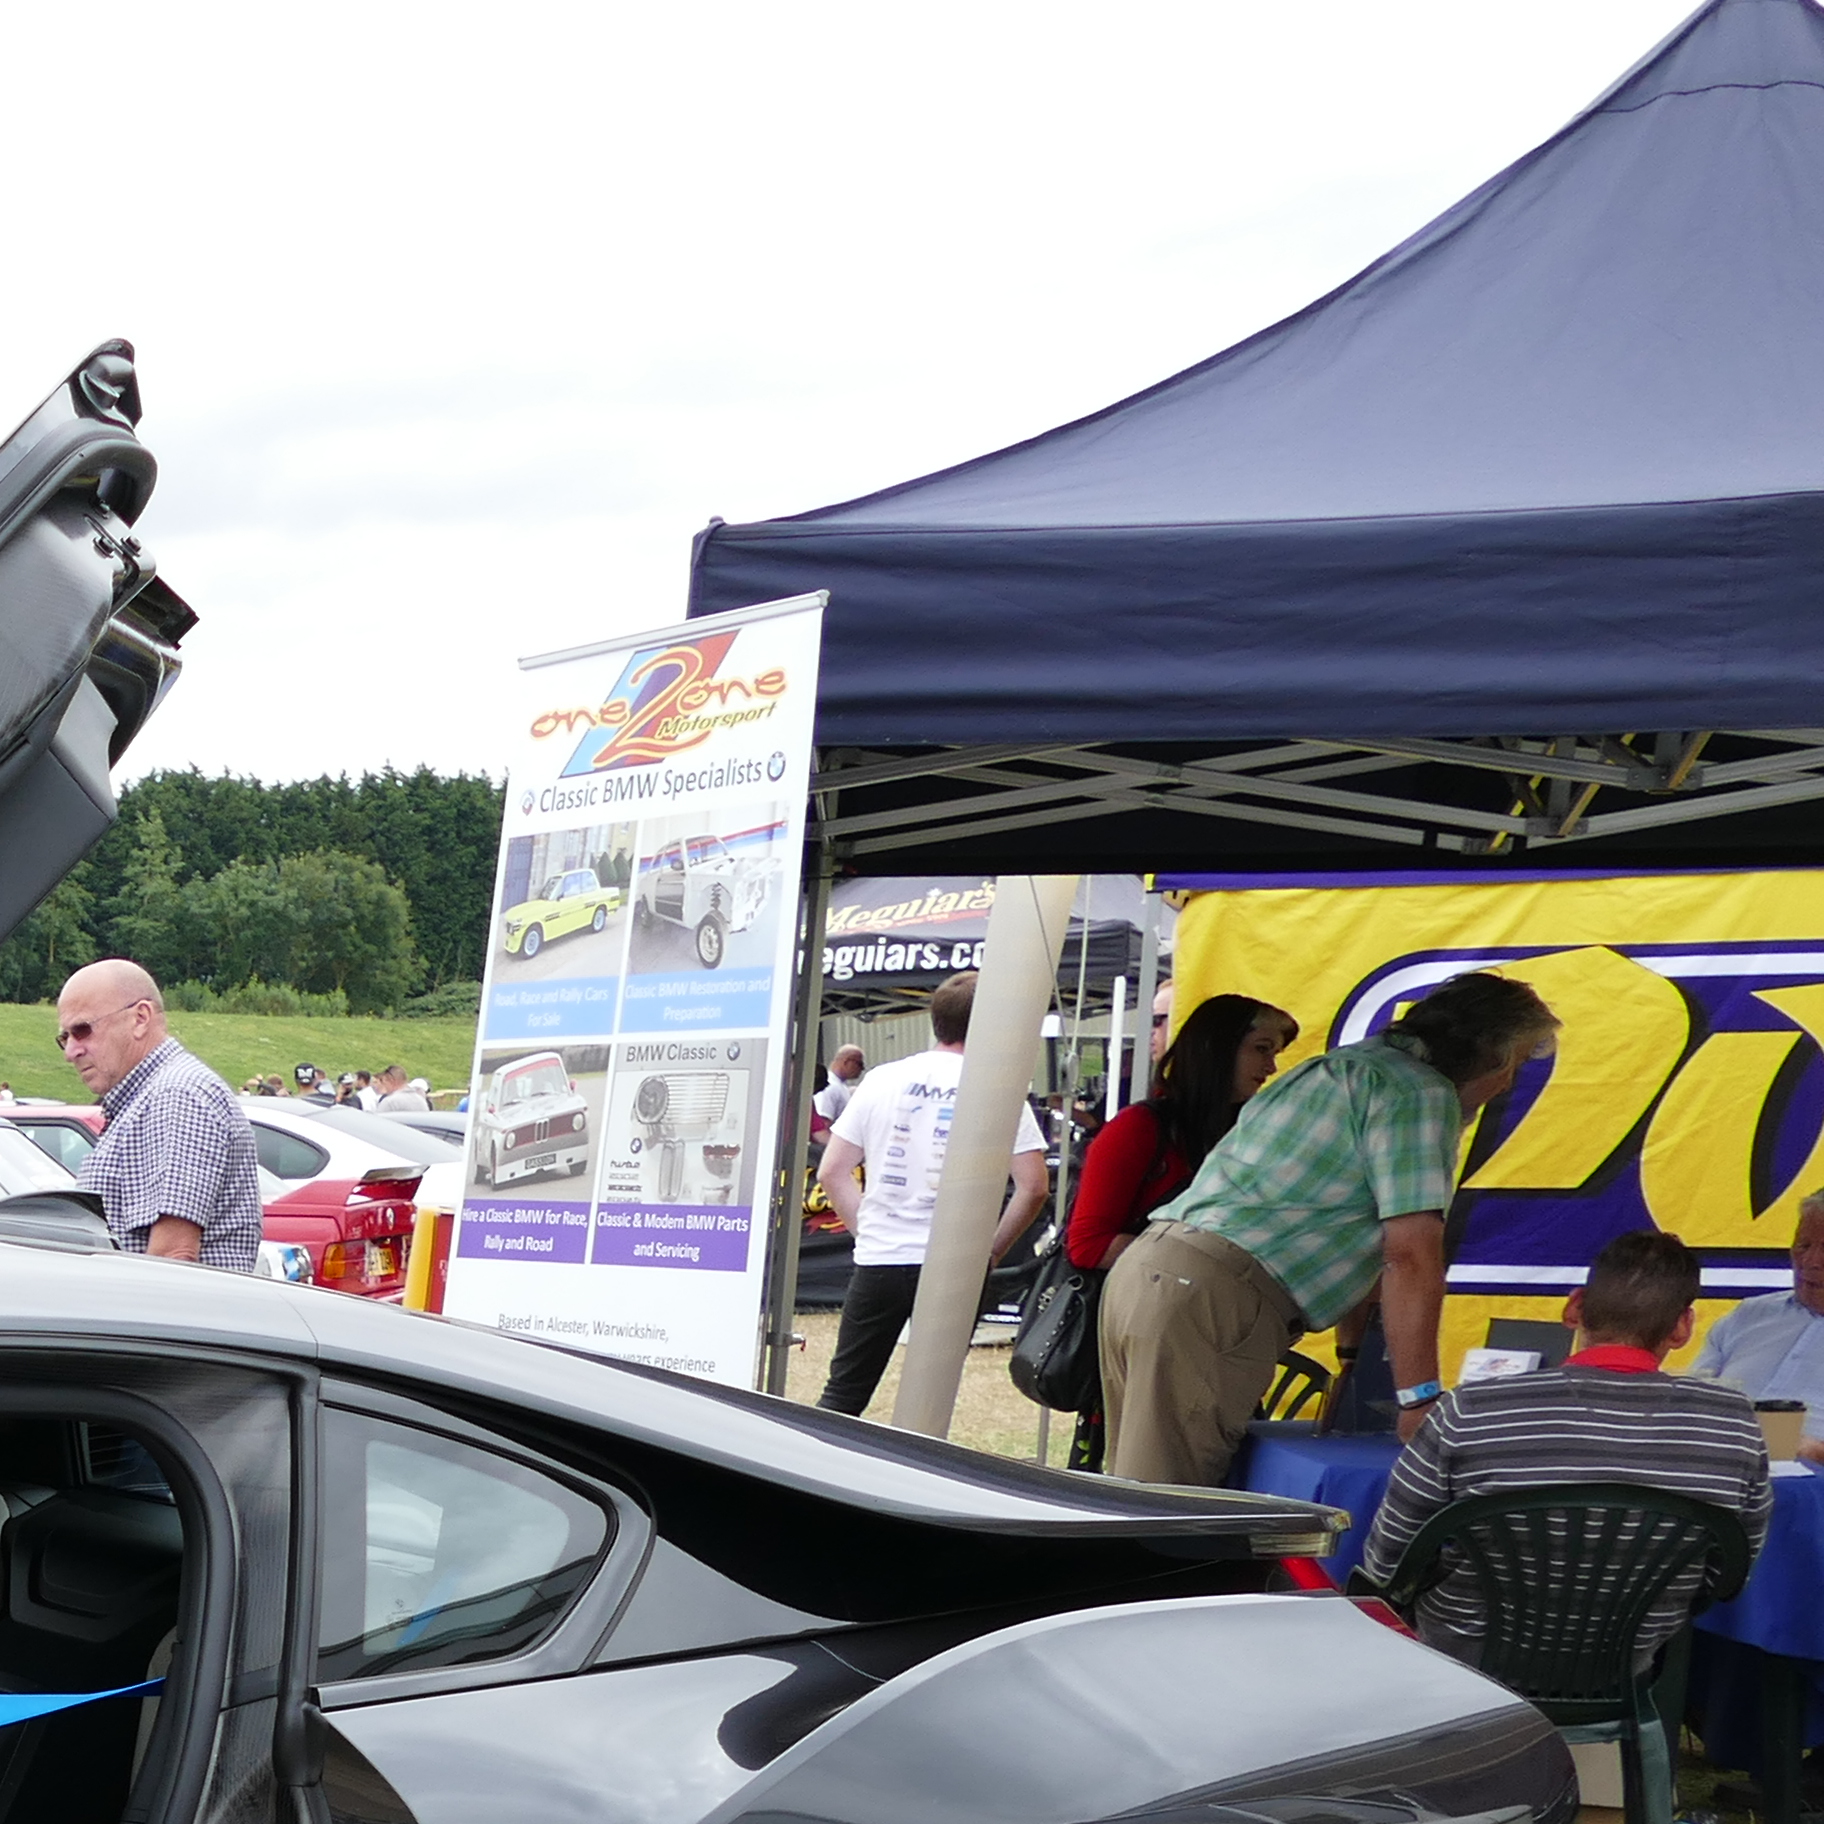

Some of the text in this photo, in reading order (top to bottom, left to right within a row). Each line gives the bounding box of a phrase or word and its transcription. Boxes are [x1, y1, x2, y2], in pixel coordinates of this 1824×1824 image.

[656, 702, 777, 740] Motorsport
[540, 758, 762, 813] Classic BMW Specialists
[798, 937, 985, 980] eguiars.co
[494, 987, 608, 1007] Road, Race and Rally Cars
[625, 976, 770, 1000] Classic BMW Restoration and
[527, 1012, 561, 1027] For Sale
[663, 1006, 722, 1023] Preparation
[626, 1043, 717, 1063] BMW Classic
[462, 1208, 479, 1222] Hire
[486, 1208, 513, 1224] Classic
[514, 1209, 544, 1224] BMW
[545, 1210, 561, 1225] for
[562, 1211, 588, 1228] Race,
[597, 1211, 749, 1232] Classic & Modern BMW Parts
[484, 1234, 554, 1252] Rally and Road
[633, 1242, 701, 1262] and Servicing
[498, 1313, 670, 1344] Based in Alcester, Warwickshire,
[654, 1356, 716, 1374] experience
